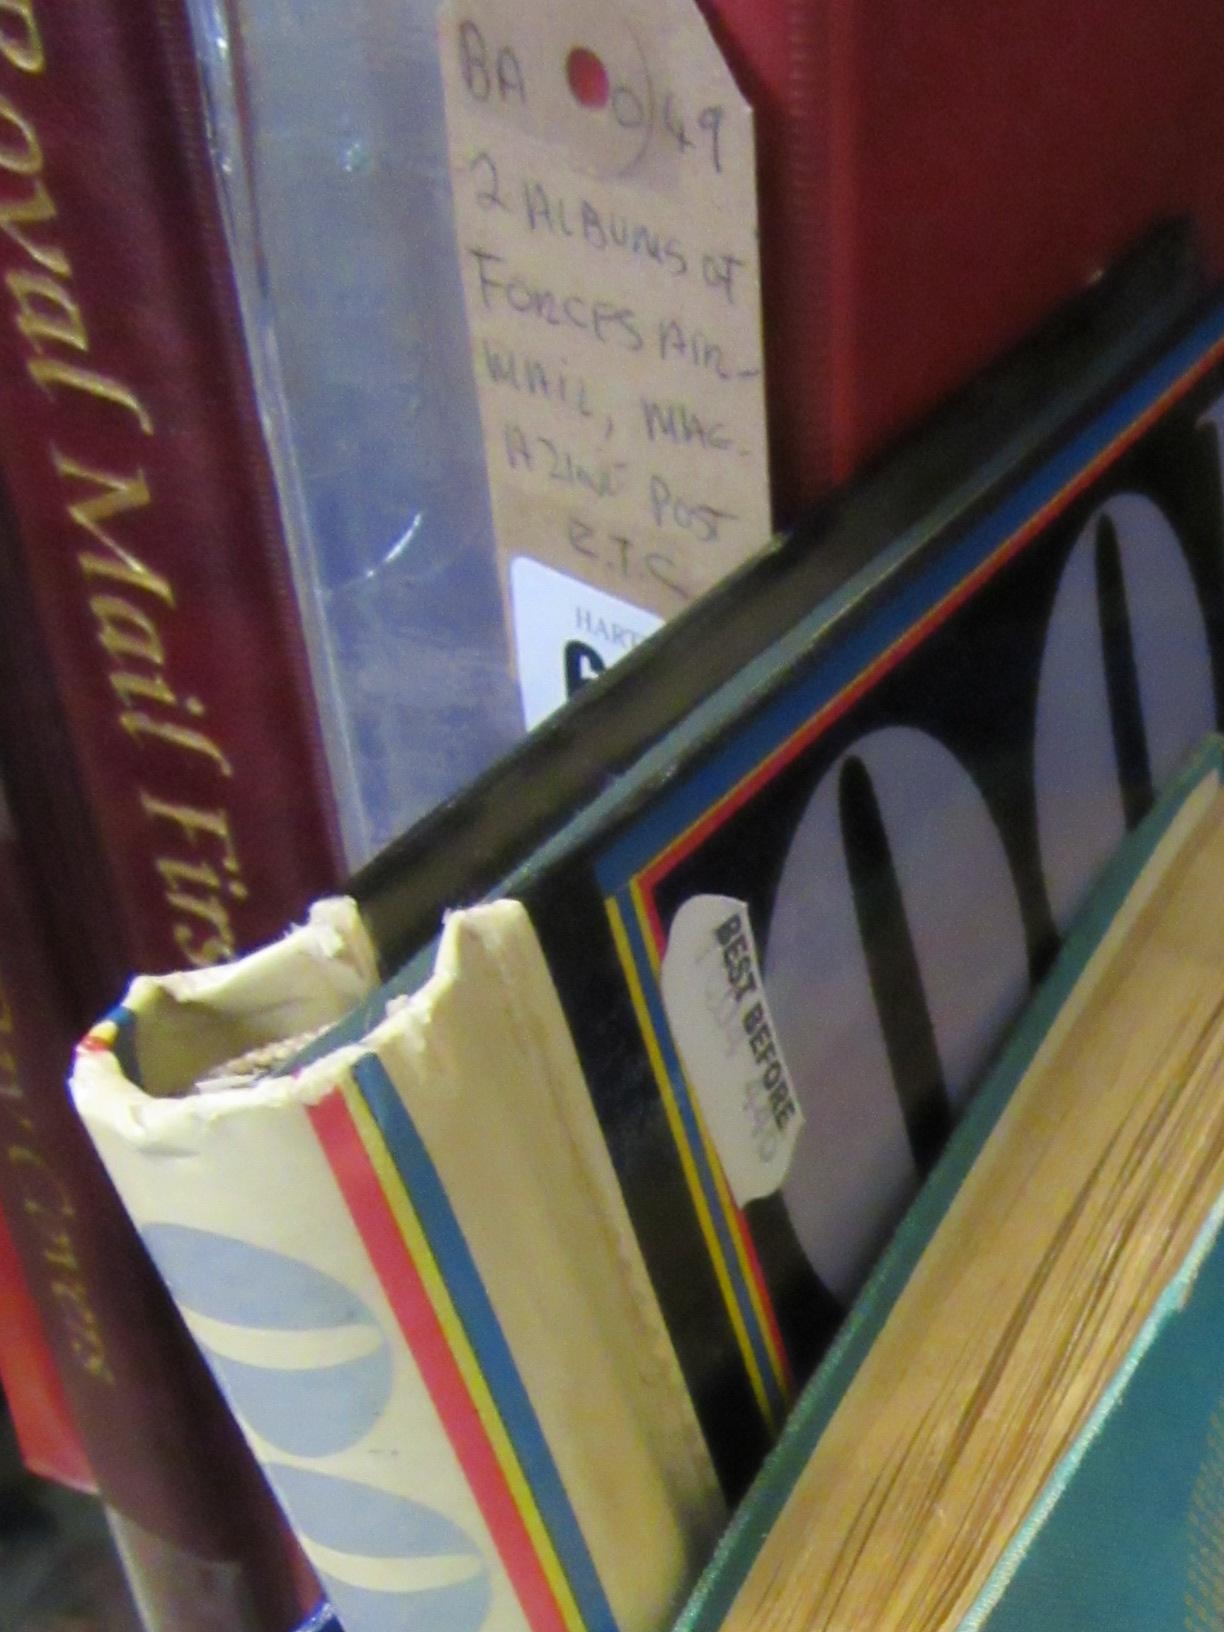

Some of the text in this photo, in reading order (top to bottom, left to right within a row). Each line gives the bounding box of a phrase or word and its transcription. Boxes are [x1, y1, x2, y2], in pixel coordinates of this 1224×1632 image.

[470, 152, 510, 212] 2
[48, 438, 233, 778] Mail
[575, 605, 644, 650] HART
[138, 791, 249, 967] Firs
[713, 913, 757, 1004] BEST
[743, 1001, 797, 1131] BEFORE
